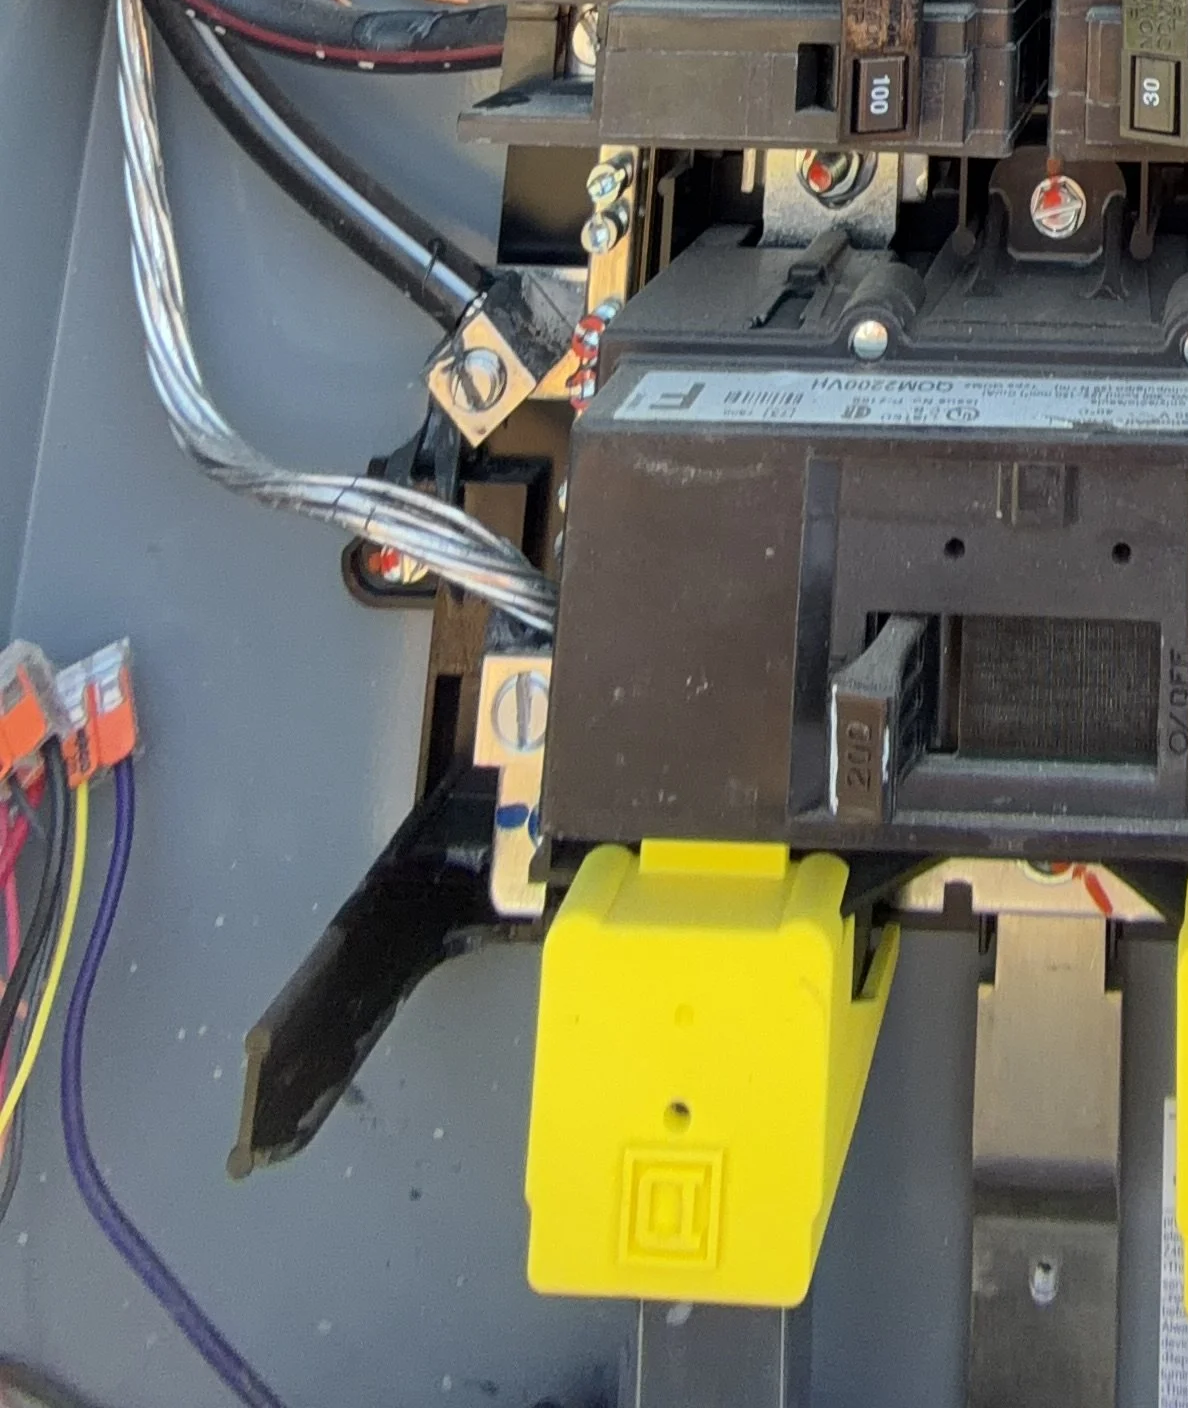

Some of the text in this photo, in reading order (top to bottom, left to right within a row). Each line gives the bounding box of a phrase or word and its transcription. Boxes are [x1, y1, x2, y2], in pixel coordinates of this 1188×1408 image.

[870, 74, 890, 114] 100
[1142, 77, 1160, 106] 30
[811, 377, 954, 393] QOM2200VH
[844, 720, 872, 791] 200
